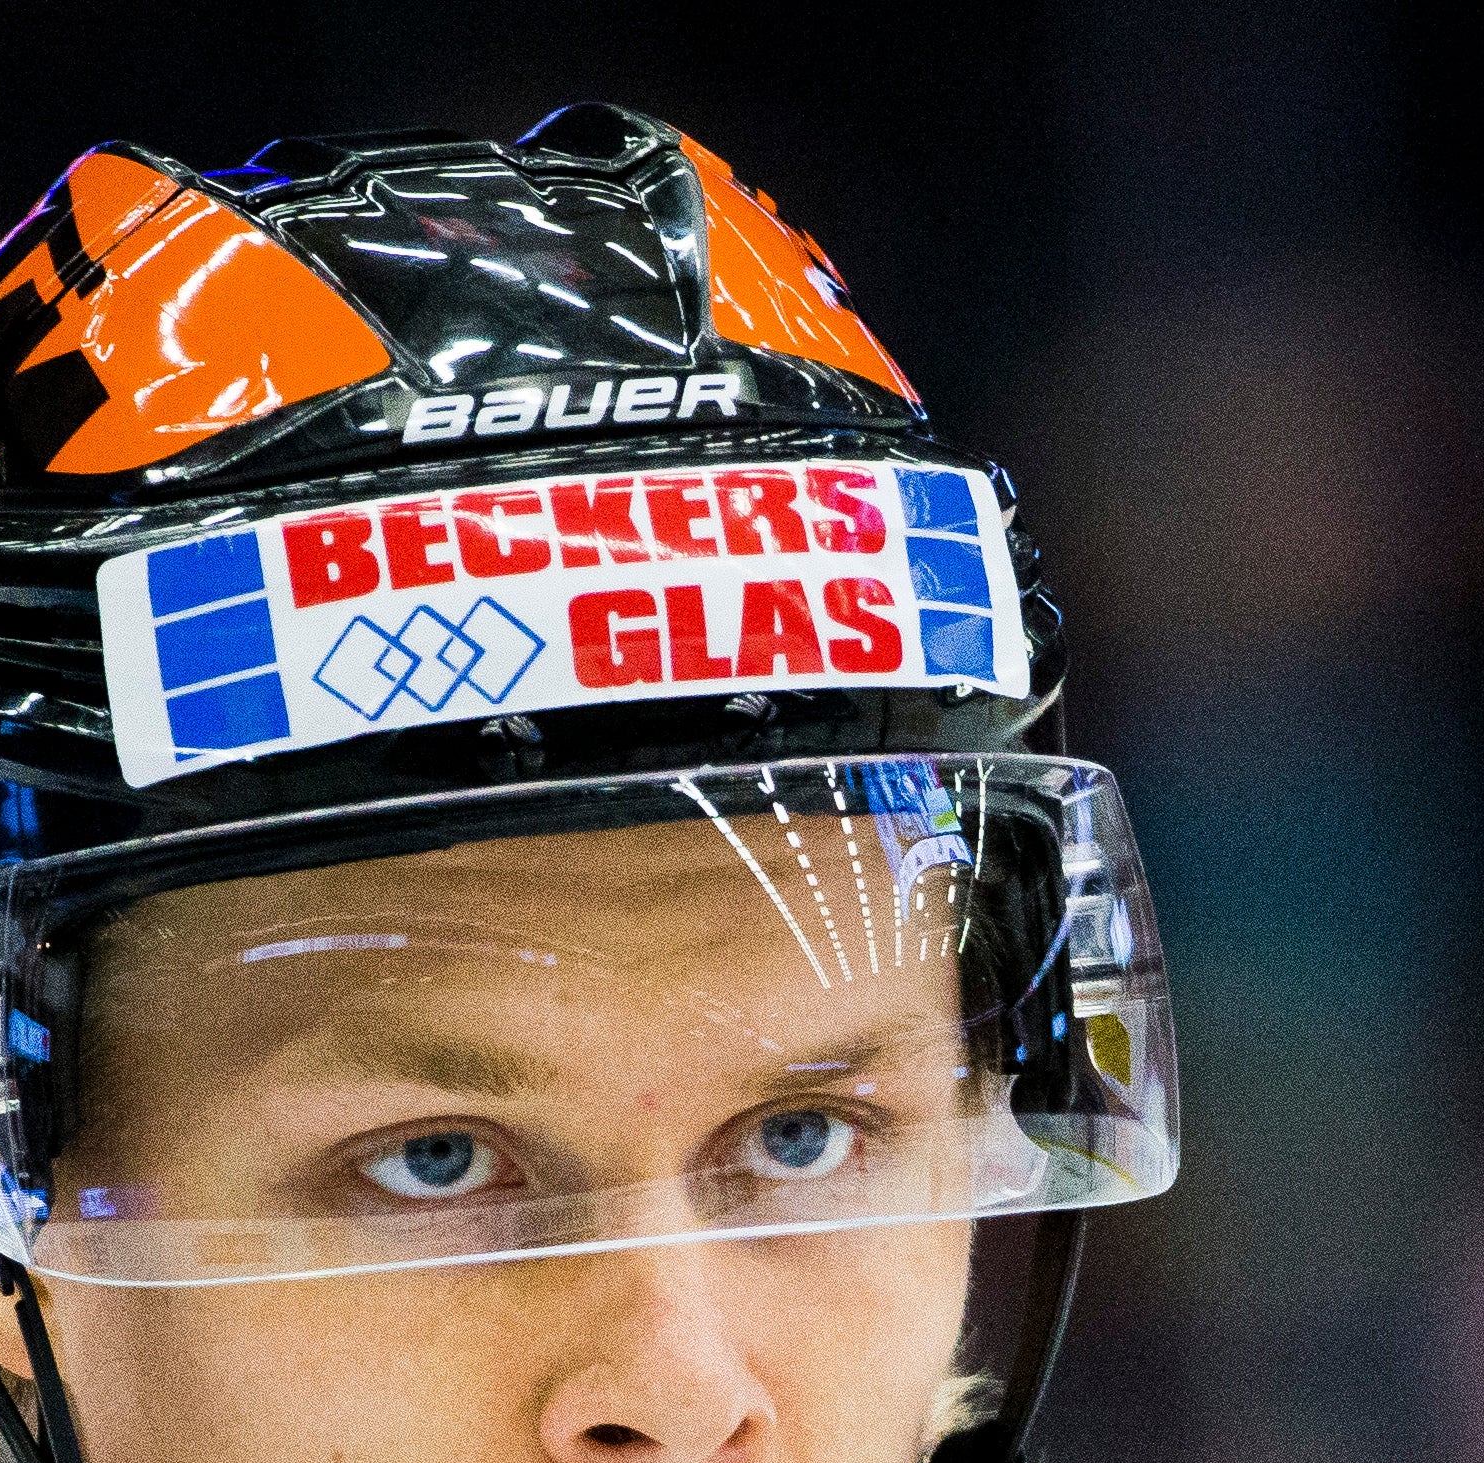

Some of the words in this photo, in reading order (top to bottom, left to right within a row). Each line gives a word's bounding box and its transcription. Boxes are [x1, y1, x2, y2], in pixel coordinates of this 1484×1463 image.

[401, 370, 742, 444] BAUER
[281, 466, 890, 608] BECKERS
[568, 577, 905, 689] GLAS
